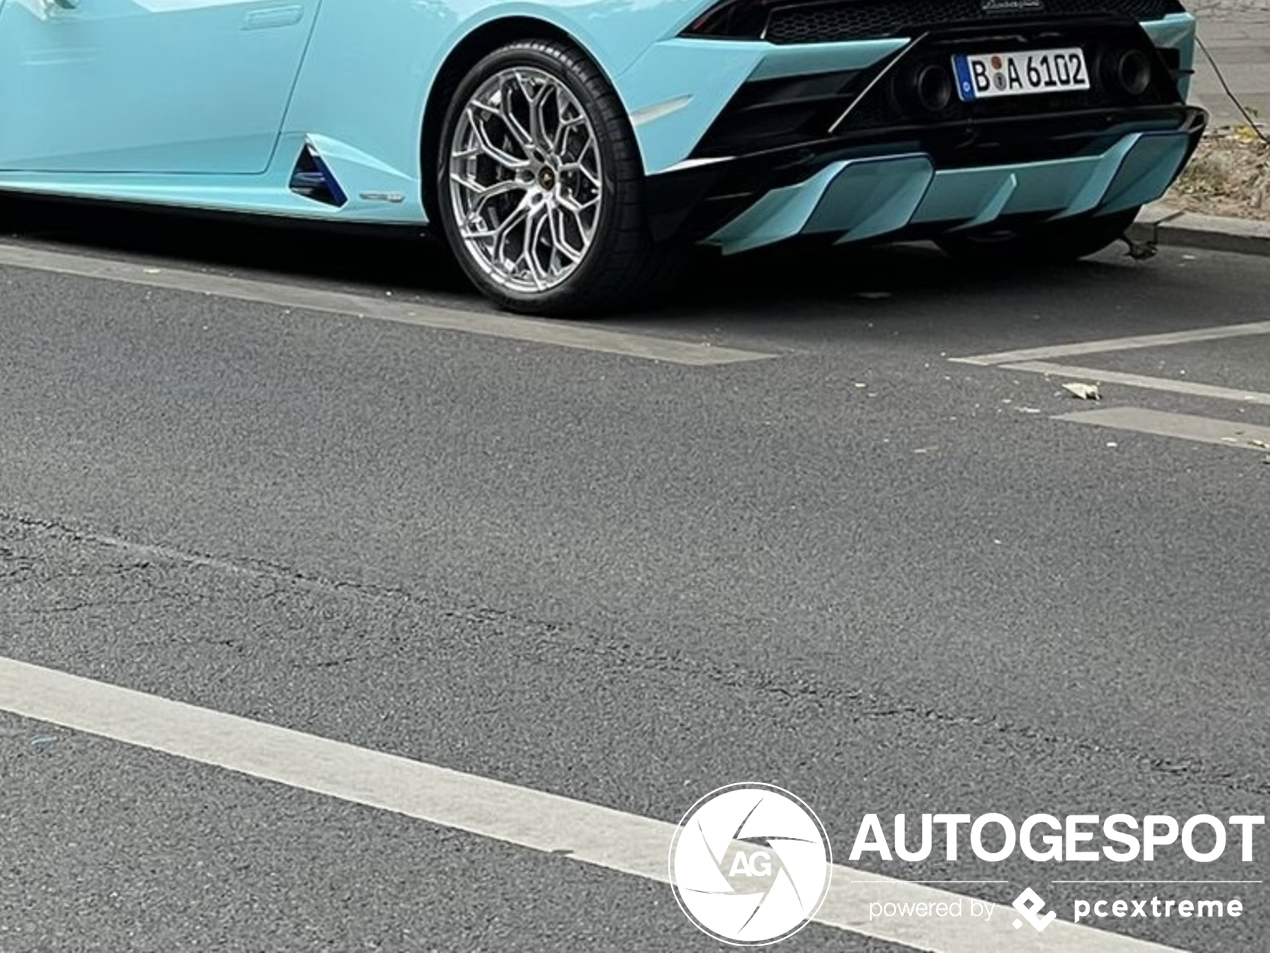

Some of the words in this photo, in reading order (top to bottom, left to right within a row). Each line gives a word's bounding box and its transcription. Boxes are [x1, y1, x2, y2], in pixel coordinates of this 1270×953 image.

[971, 60, 991, 93] B
[1007, 57, 1023, 90] A
[1026, 53, 1086, 88] 6102
